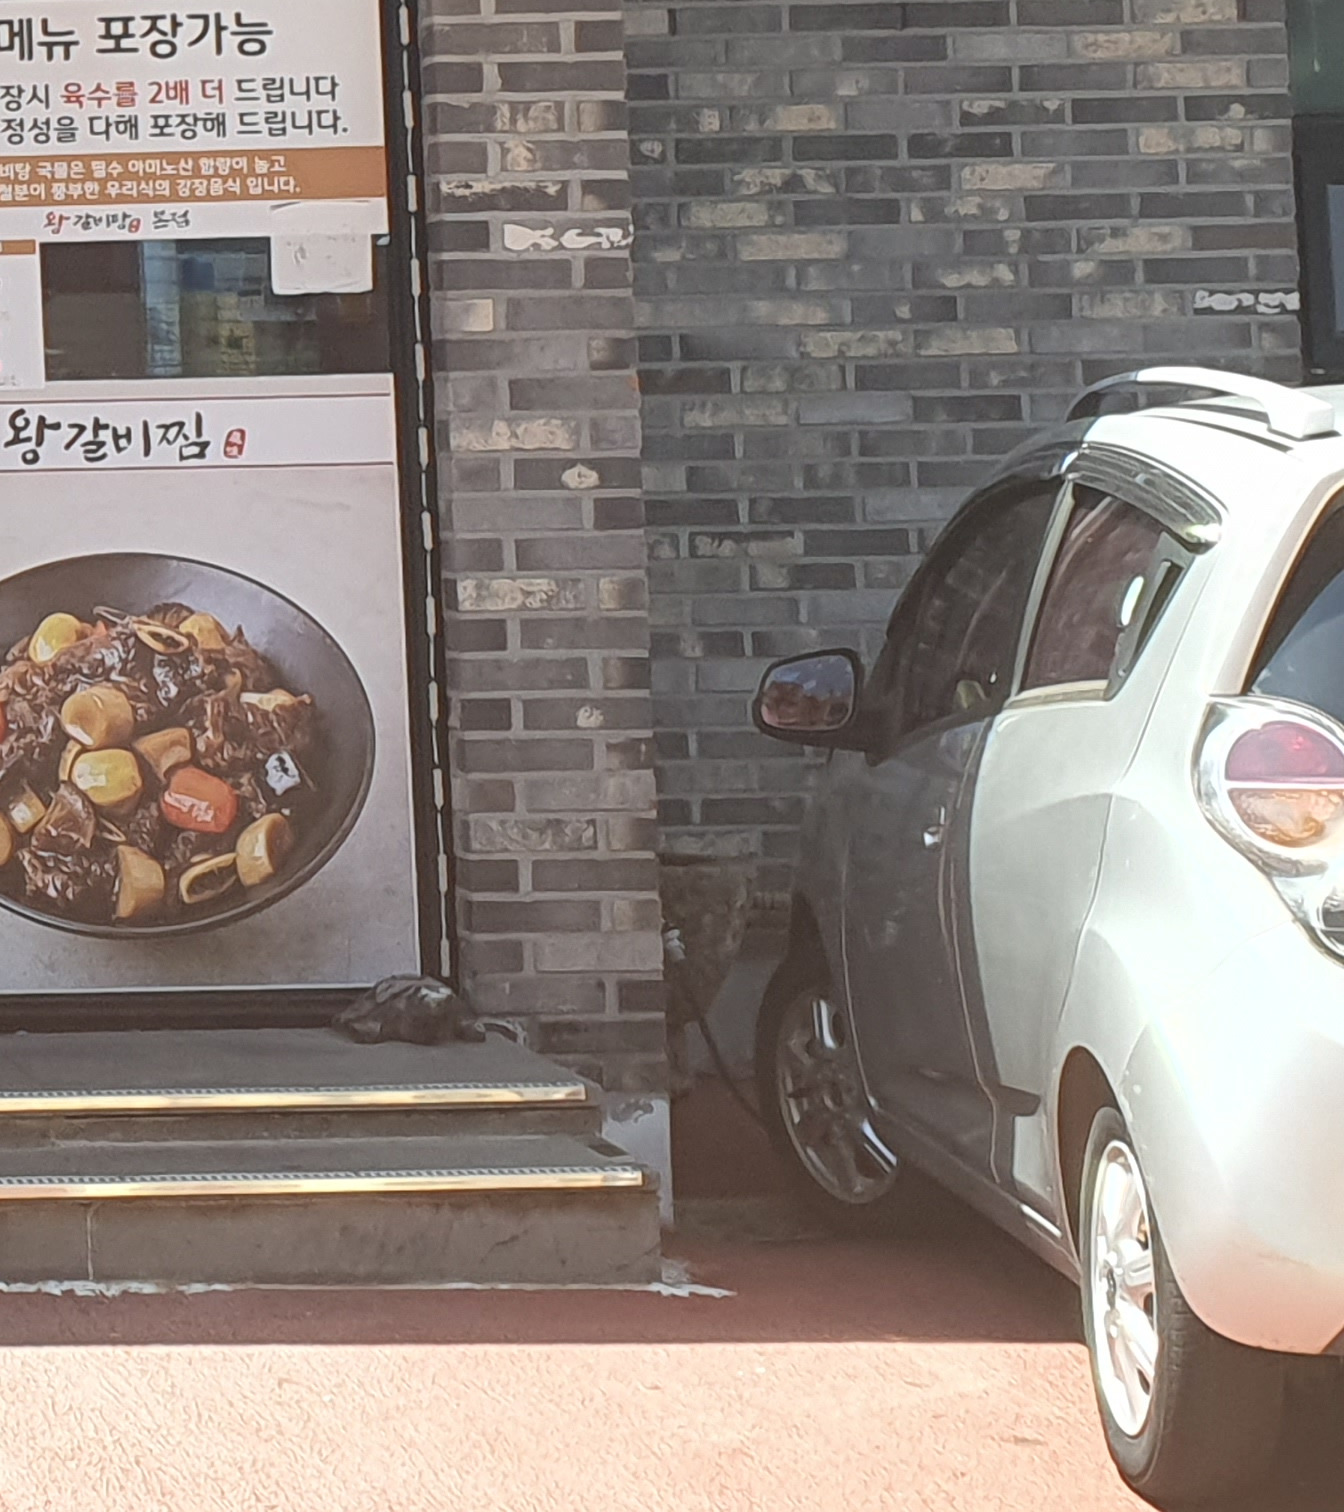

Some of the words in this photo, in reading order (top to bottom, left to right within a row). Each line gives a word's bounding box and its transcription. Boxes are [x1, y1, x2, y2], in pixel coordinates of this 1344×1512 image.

[96, 10, 273, 59] 포장가능
[61, 80, 137, 107] 육수를
[148, 79, 189, 105] 2배
[201, 78, 224, 104] 더
[235, 76, 337, 102] 드립니다
[1, 115, 78, 143] 정성을
[89, 114, 139, 141] 다해
[150, 112, 227, 139] 포장해
[237, 109, 349, 136] 드립니다.
[129, 158, 193, 176] 아미노산
[106, 180, 171, 197] 우리식의
[247, 176, 300, 194] 입니다.
